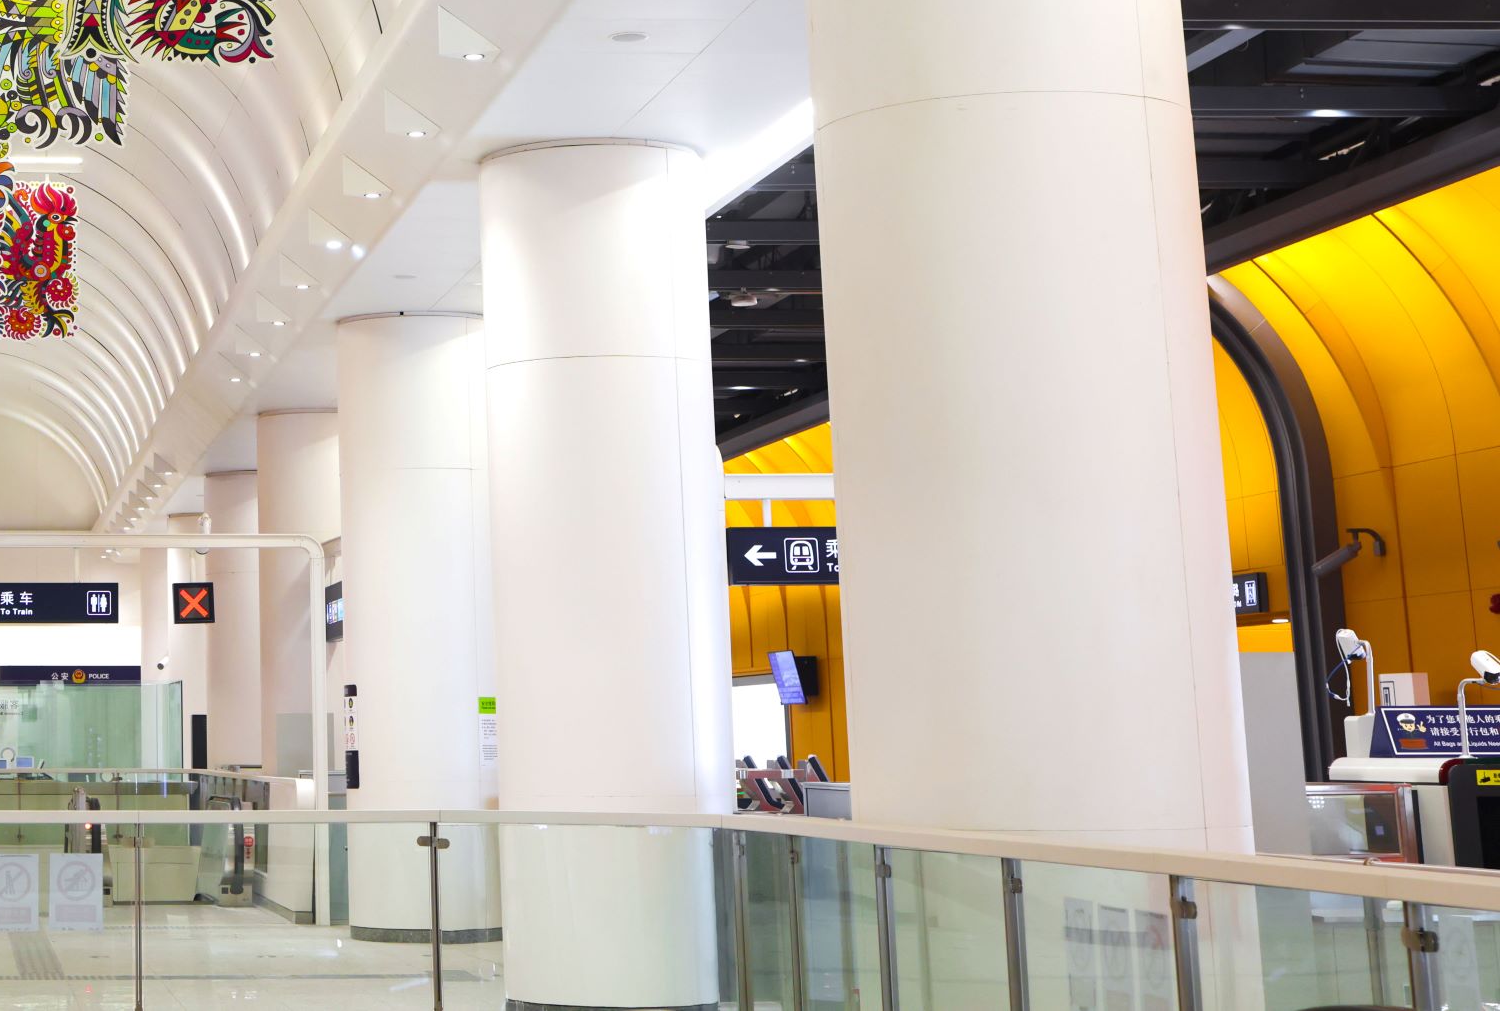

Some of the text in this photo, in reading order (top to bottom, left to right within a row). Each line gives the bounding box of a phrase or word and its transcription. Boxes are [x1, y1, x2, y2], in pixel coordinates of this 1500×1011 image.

[0, 591, 33, 605] 乘车
[51, 672, 68, 680] 公安
[1430, 727, 1499, 737] 请接受行包和
